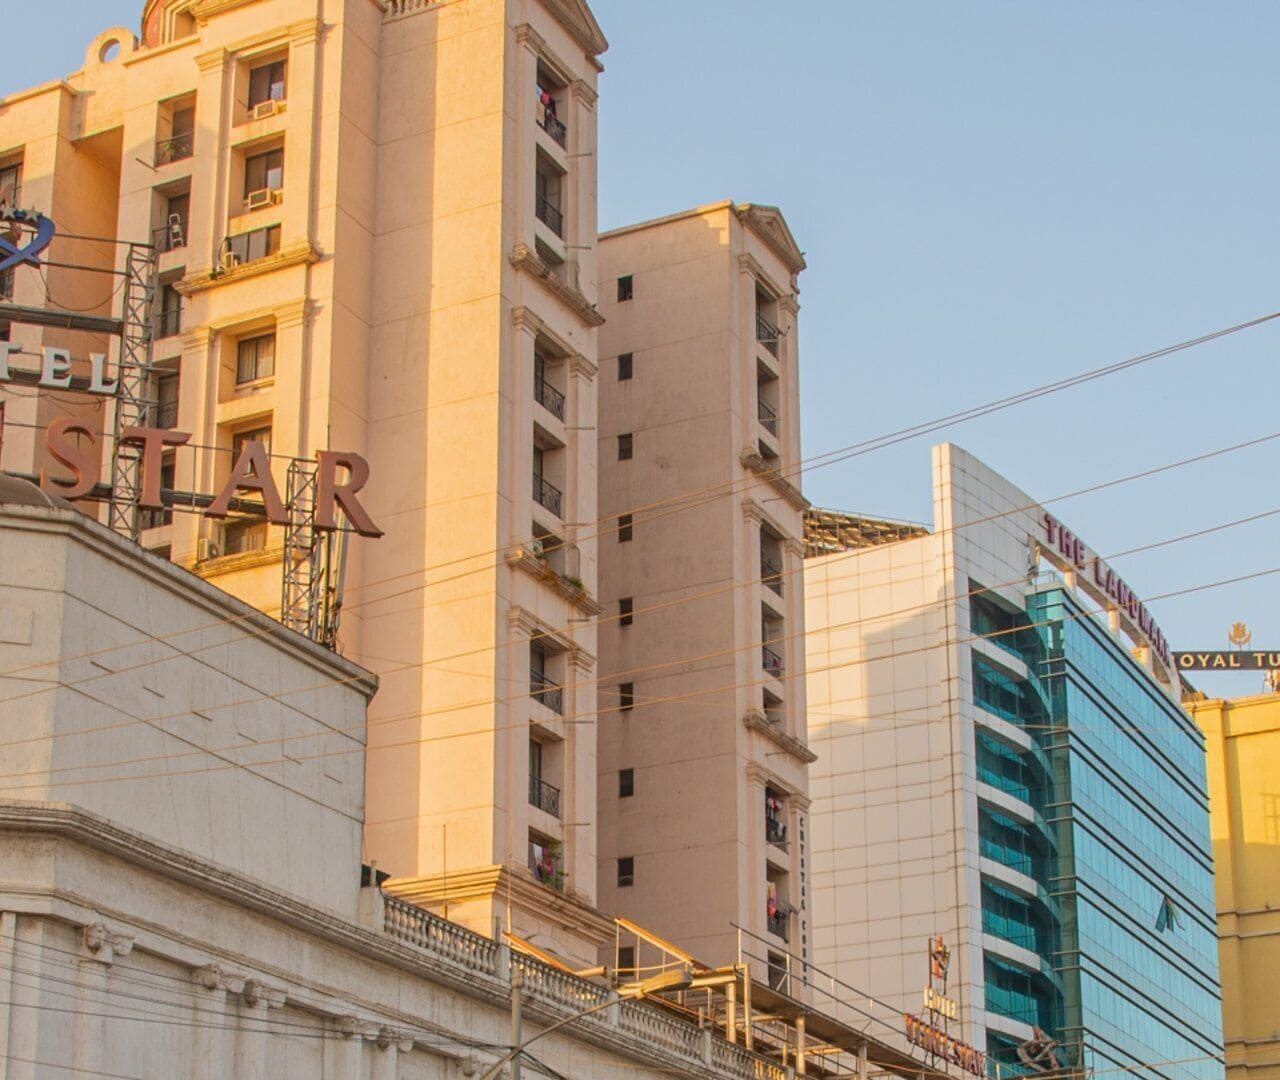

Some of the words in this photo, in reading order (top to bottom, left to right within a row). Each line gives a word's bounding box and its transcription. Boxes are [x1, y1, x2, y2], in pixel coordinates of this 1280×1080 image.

[39, 416, 385, 539] STAR
[1044, 514, 1086, 570] THE
[1172, 652, 1241, 669] OYAL
